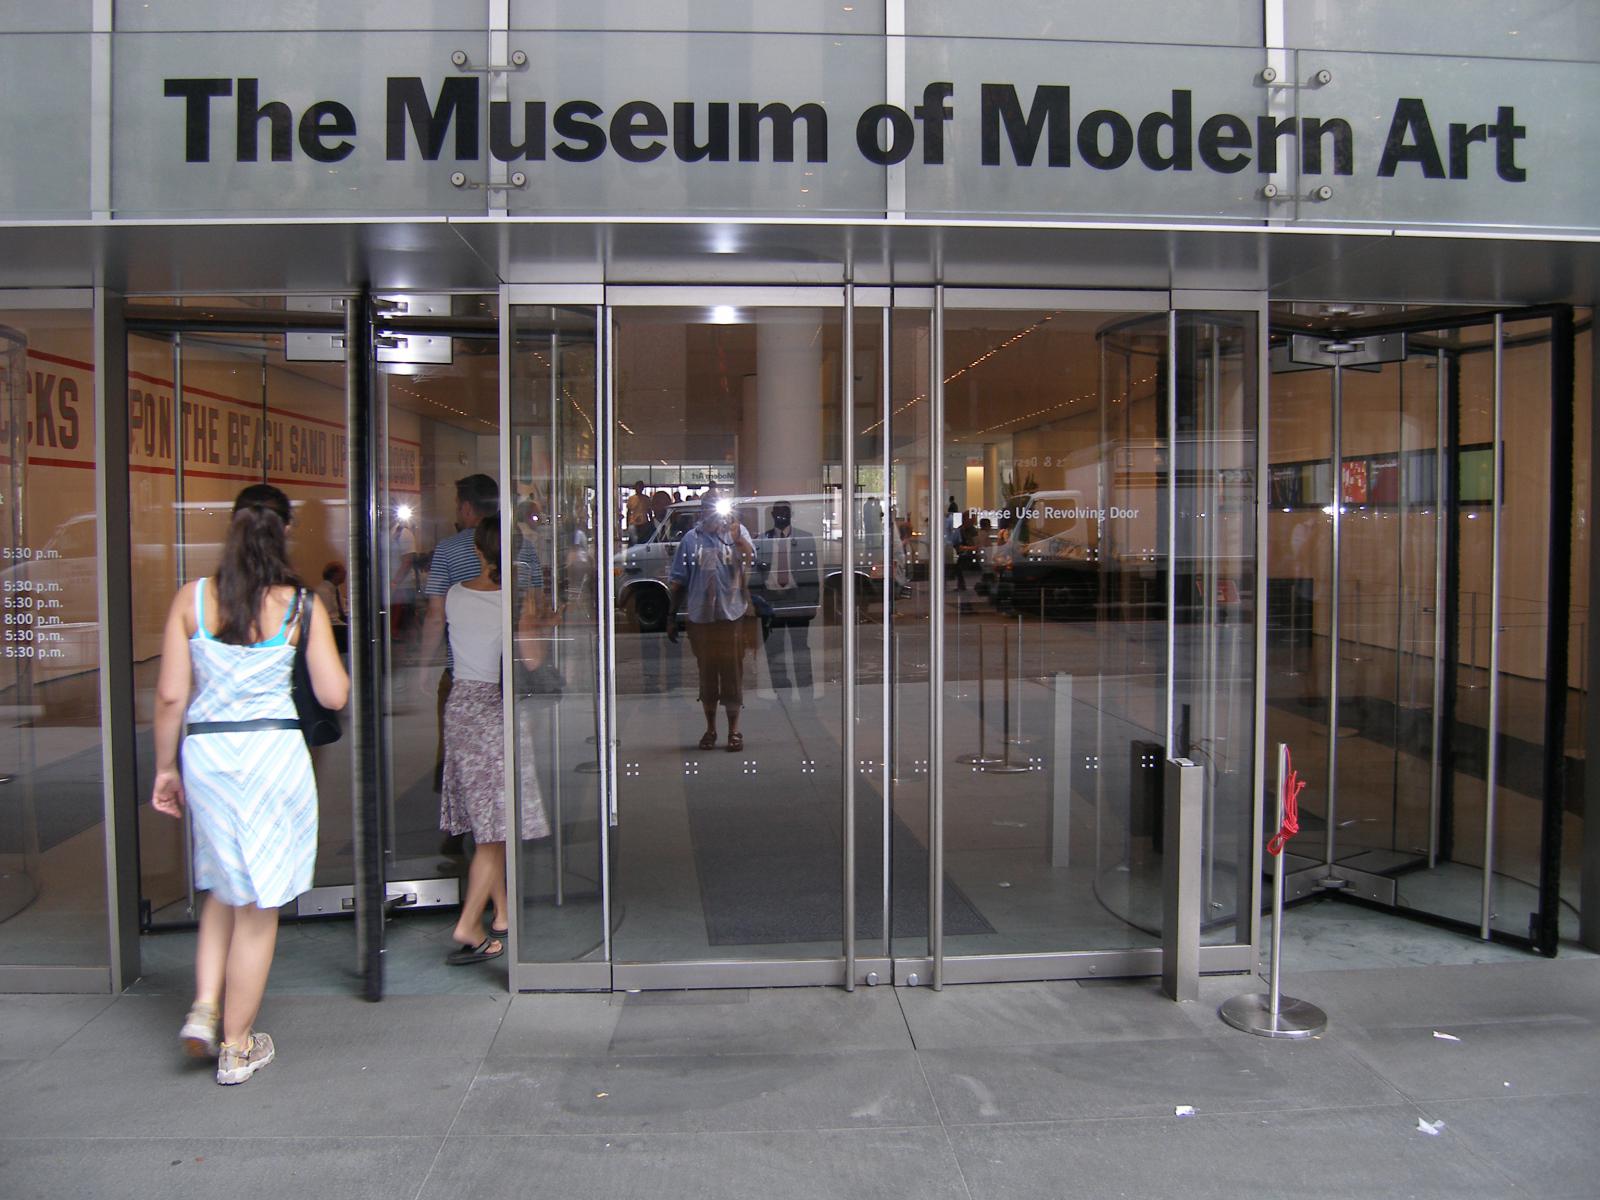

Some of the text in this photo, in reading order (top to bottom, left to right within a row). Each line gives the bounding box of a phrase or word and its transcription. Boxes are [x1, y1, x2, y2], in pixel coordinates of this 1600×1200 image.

[163, 76, 1527, 183] The Museum of Modern Art
[128, 388, 172, 459] PON
[182, 401, 220, 464] THE
[227, 411, 284, 472] BEACH
[289, 424, 327, 476] SAND
[1015, 507, 1040, 519] Use
[1044, 506, 1106, 521] Revolving
[1110, 507, 1140, 519] Door
[3, 548, 62, 561] 5:30 p.m.
[3, 580, 64, 594] 5:30 p.m.
[4, 597, 64, 610] 5:30 p.m.
[4, 613, 64, 627] 8:00 p.m.
[5, 630, 65, 643] 5:30 p.m.
[5, 646, 65, 660] 5:30 p.m.
